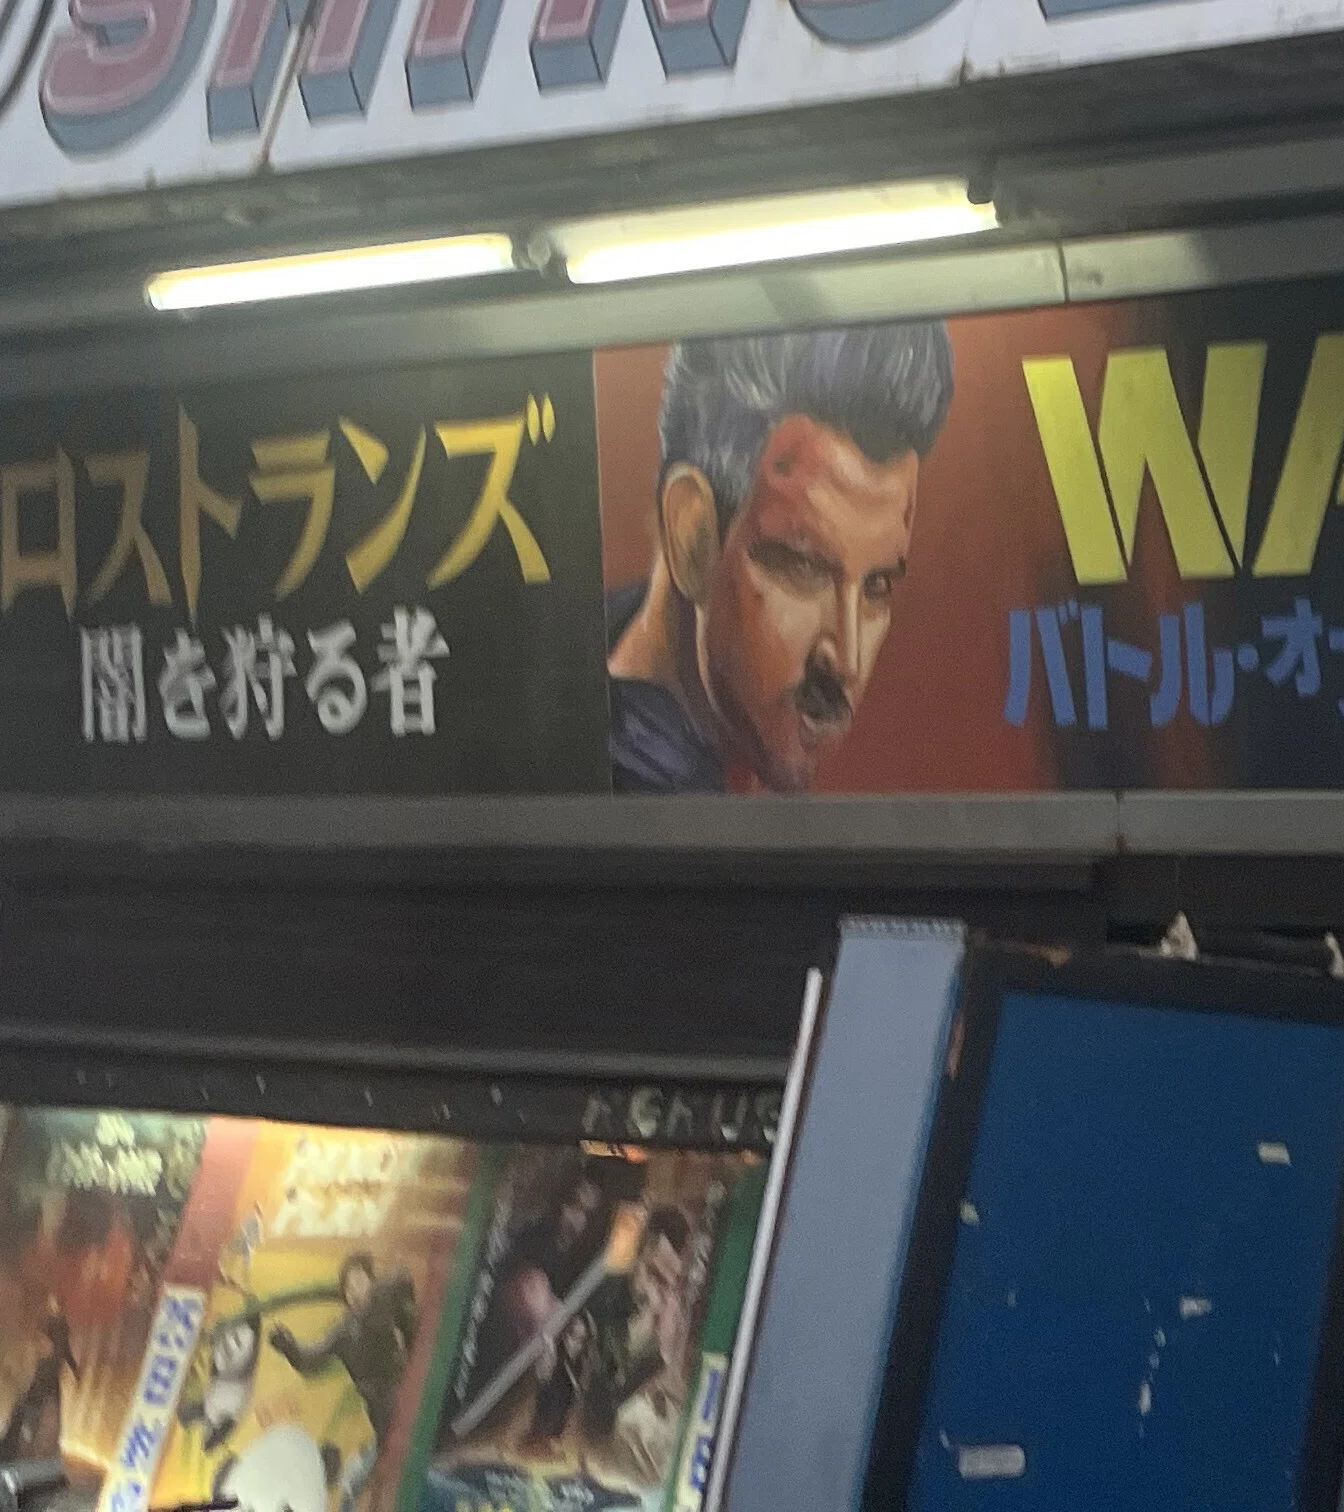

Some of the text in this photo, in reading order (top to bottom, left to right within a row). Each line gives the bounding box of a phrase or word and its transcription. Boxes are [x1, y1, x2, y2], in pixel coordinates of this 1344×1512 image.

[0, 391, 557, 630] ロストランズ
[80, 604, 452, 744] 闇を狩る者
